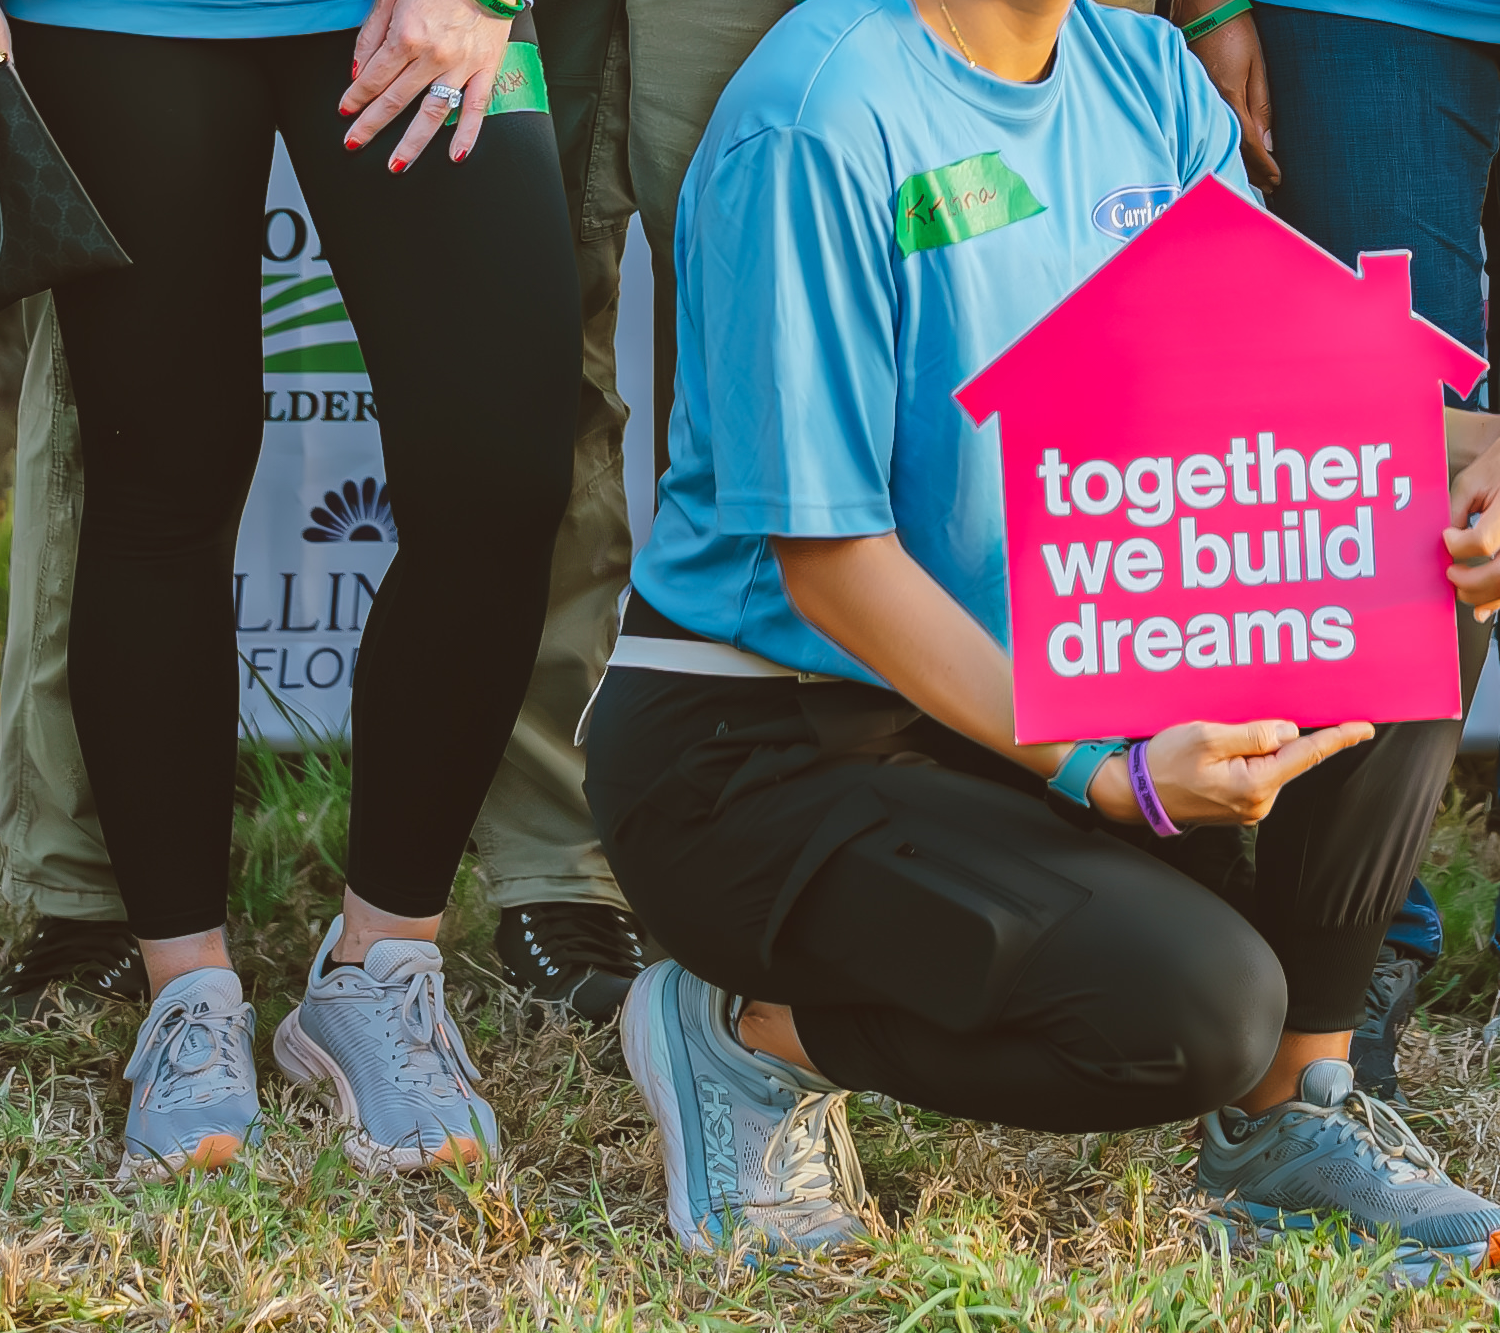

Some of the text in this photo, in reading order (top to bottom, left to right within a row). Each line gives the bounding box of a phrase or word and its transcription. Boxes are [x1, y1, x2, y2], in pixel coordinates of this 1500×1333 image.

[1037, 432, 1412, 526] together,
[1041, 507, 1375, 596] we build
[1047, 603, 1355, 677] dreams
